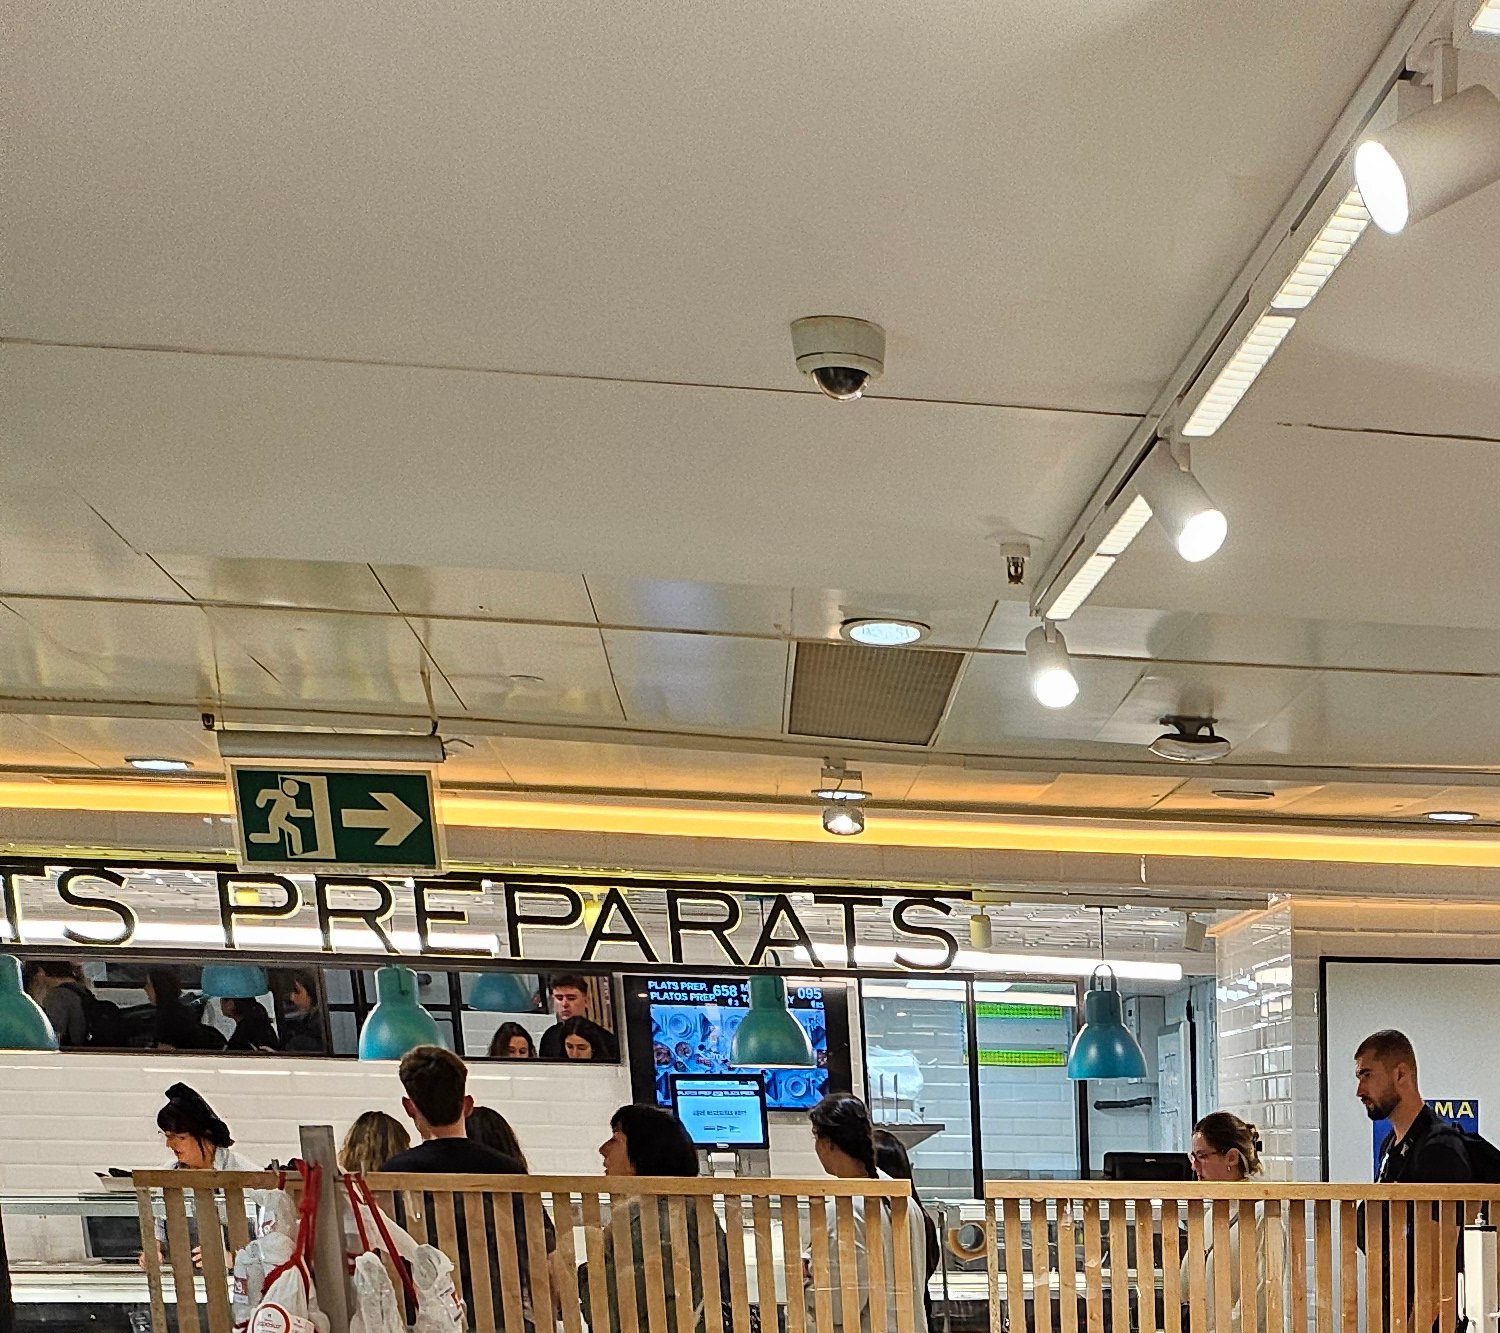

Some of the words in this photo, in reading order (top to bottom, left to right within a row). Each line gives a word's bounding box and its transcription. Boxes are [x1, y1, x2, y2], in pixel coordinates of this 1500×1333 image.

[217, 872, 959, 971] PREPARATS
[648, 981, 679, 991] PLATS
[713, 984, 738, 997] 658
[650, 992, 688, 1001] PLATOS
[797, 987, 822, 999] 095
